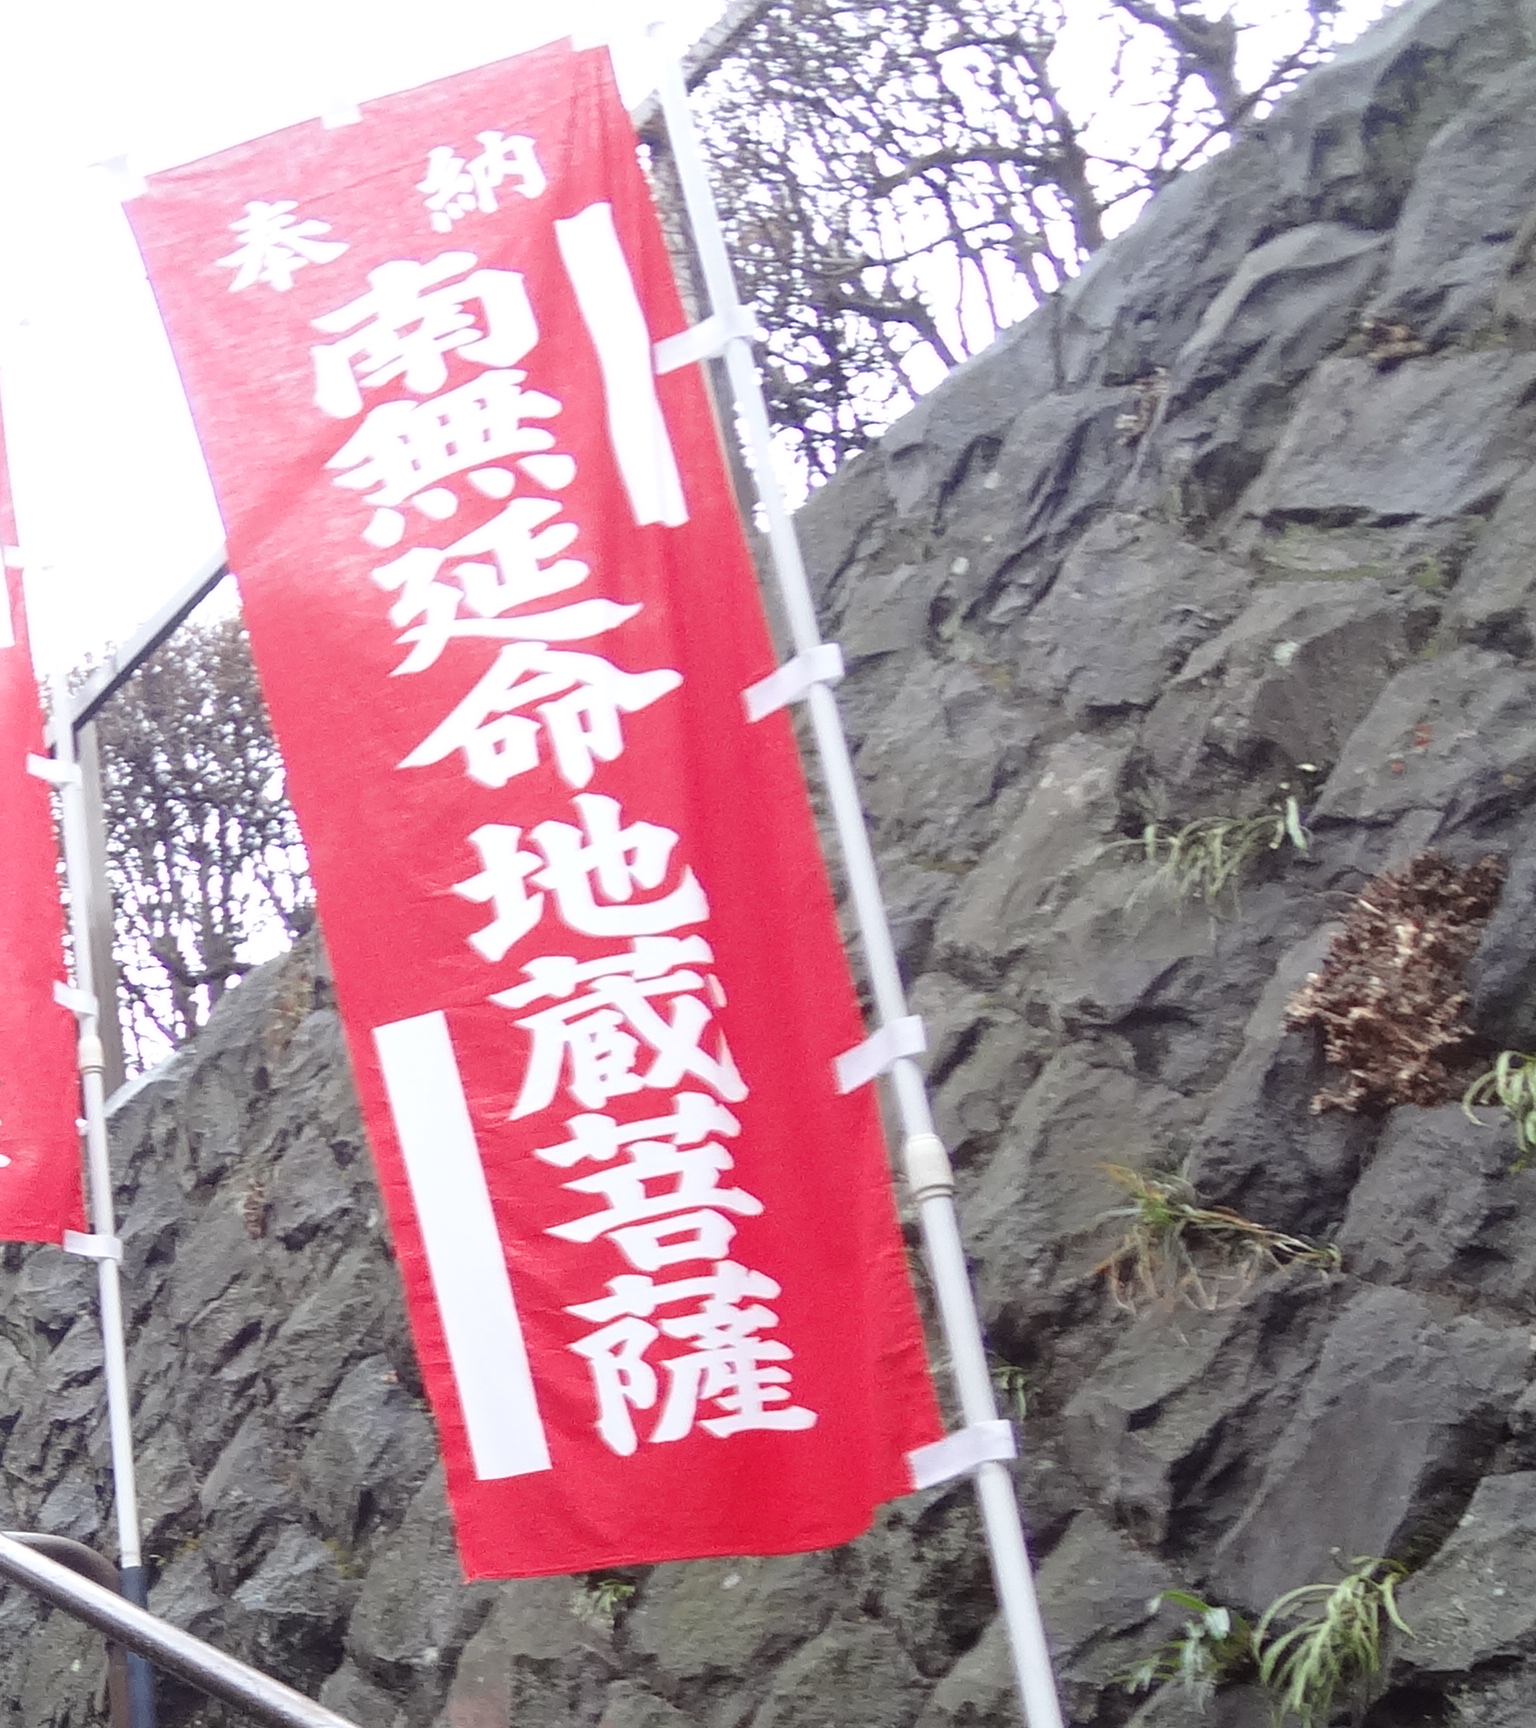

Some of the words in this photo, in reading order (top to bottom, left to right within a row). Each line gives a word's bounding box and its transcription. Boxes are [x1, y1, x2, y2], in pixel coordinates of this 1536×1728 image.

[311, 248, 818, 1458] 南無延命地蔵菩薩
